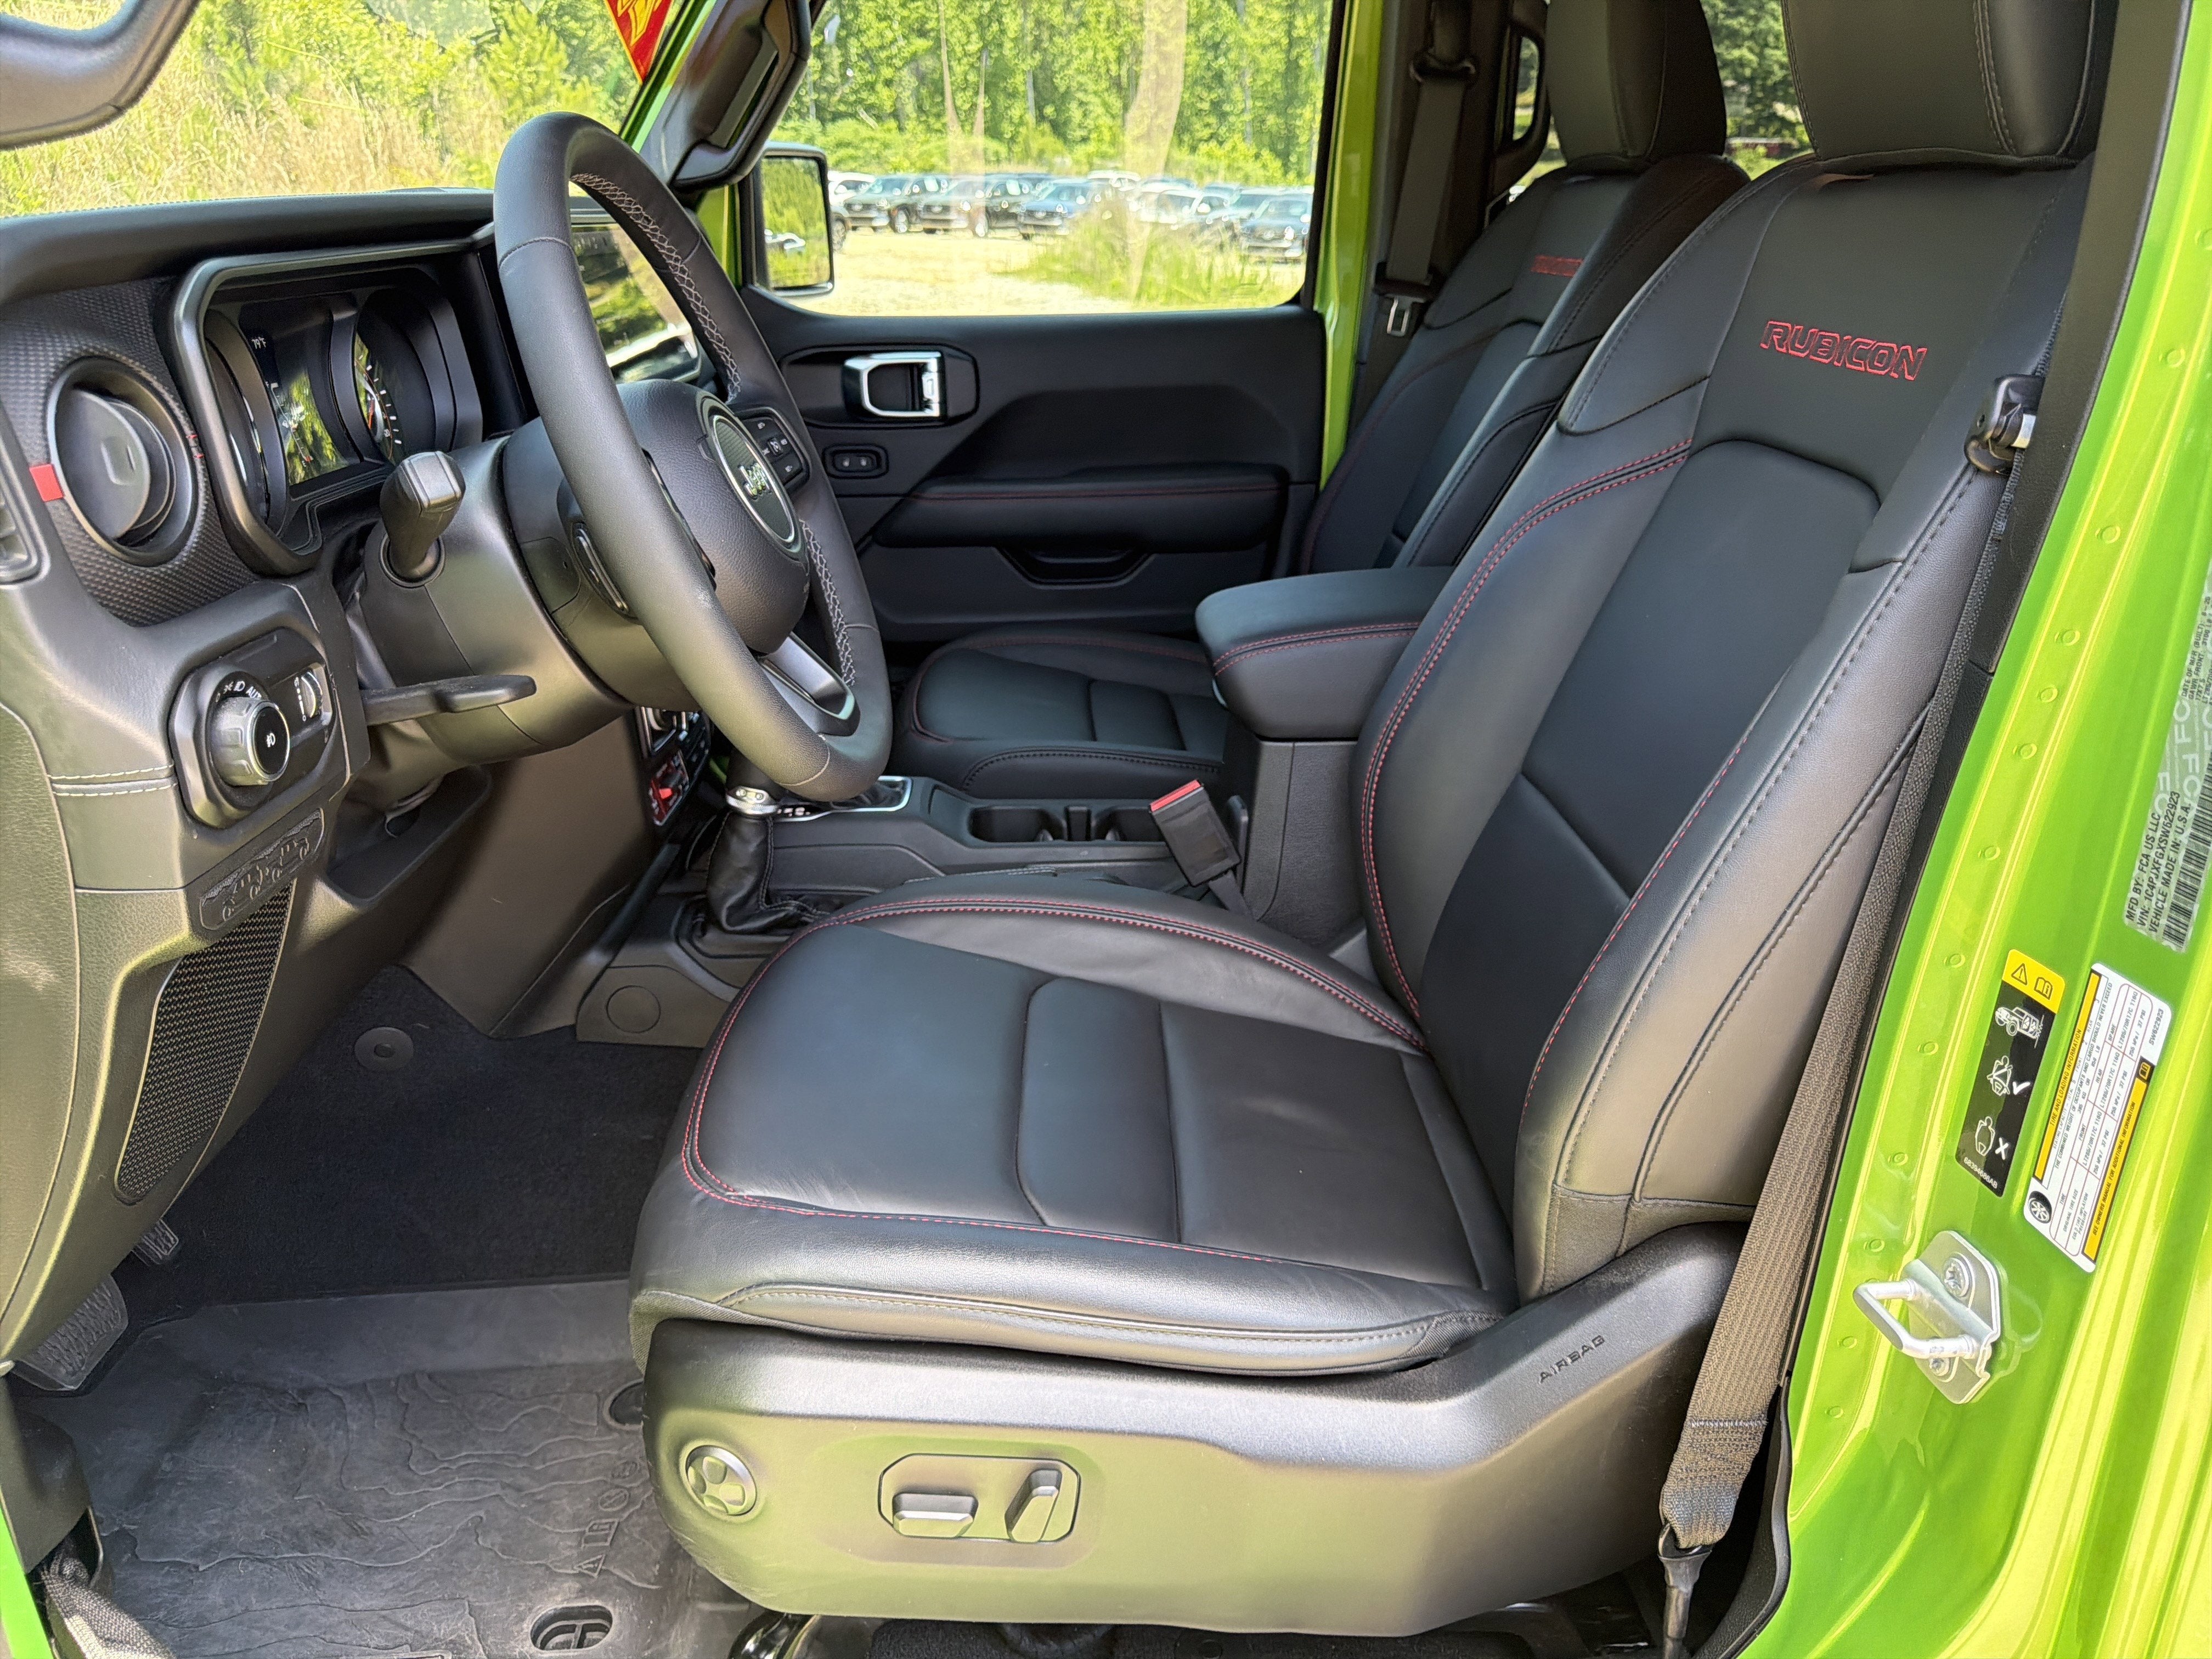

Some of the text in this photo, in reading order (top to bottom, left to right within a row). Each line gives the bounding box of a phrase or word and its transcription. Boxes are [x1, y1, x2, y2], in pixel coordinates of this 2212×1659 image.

[1759, 320, 1928, 381] RUBICON
[2125, 811, 2161, 922] MFD BY: FCA US LLC
[2136, 789, 2180, 928] VIN: 1C4PJXFGXSW622923
[2148, 799, 2191, 934] VEHICLE MADE IN: U.S.A.
[2107, 1023, 2116, 1042] SPARE
[2137, 1019, 2143, 1028] 37
[2148, 1007, 2164, 1046] SW622923
[2066, 1028, 2081, 1071] INFORMATION
[2057, 1132, 2068, 1159] COMBINED
[2066, 1112, 2074, 1132] WEIGHT
[2073, 1073, 2085, 1104] OCCUPANTS
[2086, 1042, 2095, 1062] CARGO
[2091, 1021, 2101, 1043] SHOULD
[2097, 1003, 2106, 1022] NEVER
[2103, 981, 2113, 1003] EXCEED
[2057, 1070, 2069, 1098] LOADING
[2085, 1077, 2091, 1086] OR
[2118, 1080, 2125, 1089] 37
[2053, 1097, 2062, 1113] AND
[2078, 1122, 2086, 1141] FRONT
[2101, 1139, 2107, 1147] 37
[2095, 1202, 2105, 1225] OWNERS
[2102, 1181, 2111, 1203] MANUAL
[2112, 1138, 2124, 1170] ADDITIONAL
[2121, 1100, 2136, 1138] INFORMATION
[2063, 1210, 2072, 1232] ORIGINAL
[1537, 1335, 1605, 1384] AIRBAG
